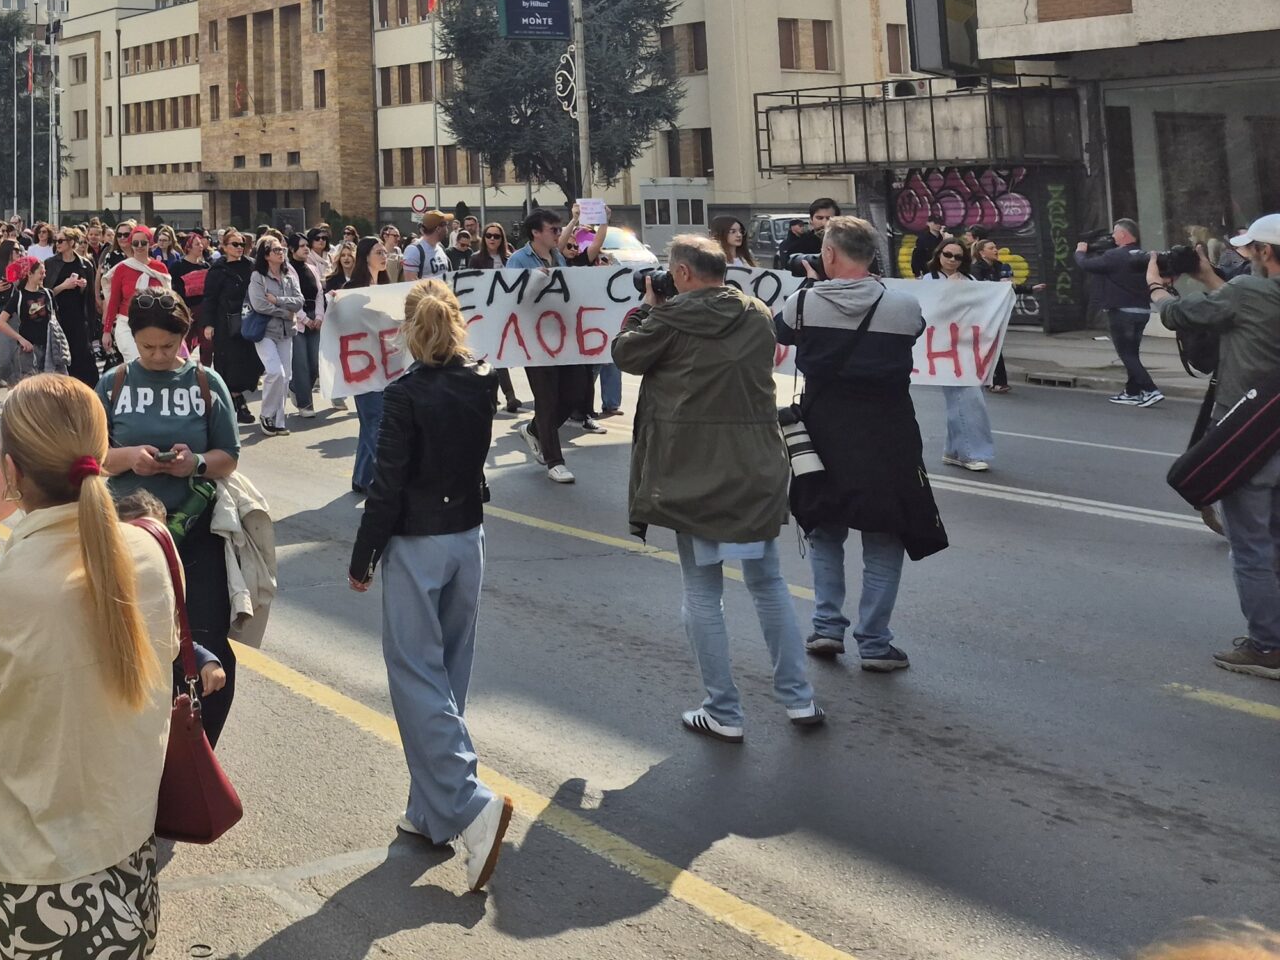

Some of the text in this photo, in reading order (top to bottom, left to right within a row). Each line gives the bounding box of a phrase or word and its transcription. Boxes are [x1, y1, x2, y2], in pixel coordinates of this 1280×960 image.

[443, 269, 570, 311] ЕМА
[339, 327, 405, 383] БЕ
[107, 385, 216, 417] AP 196
